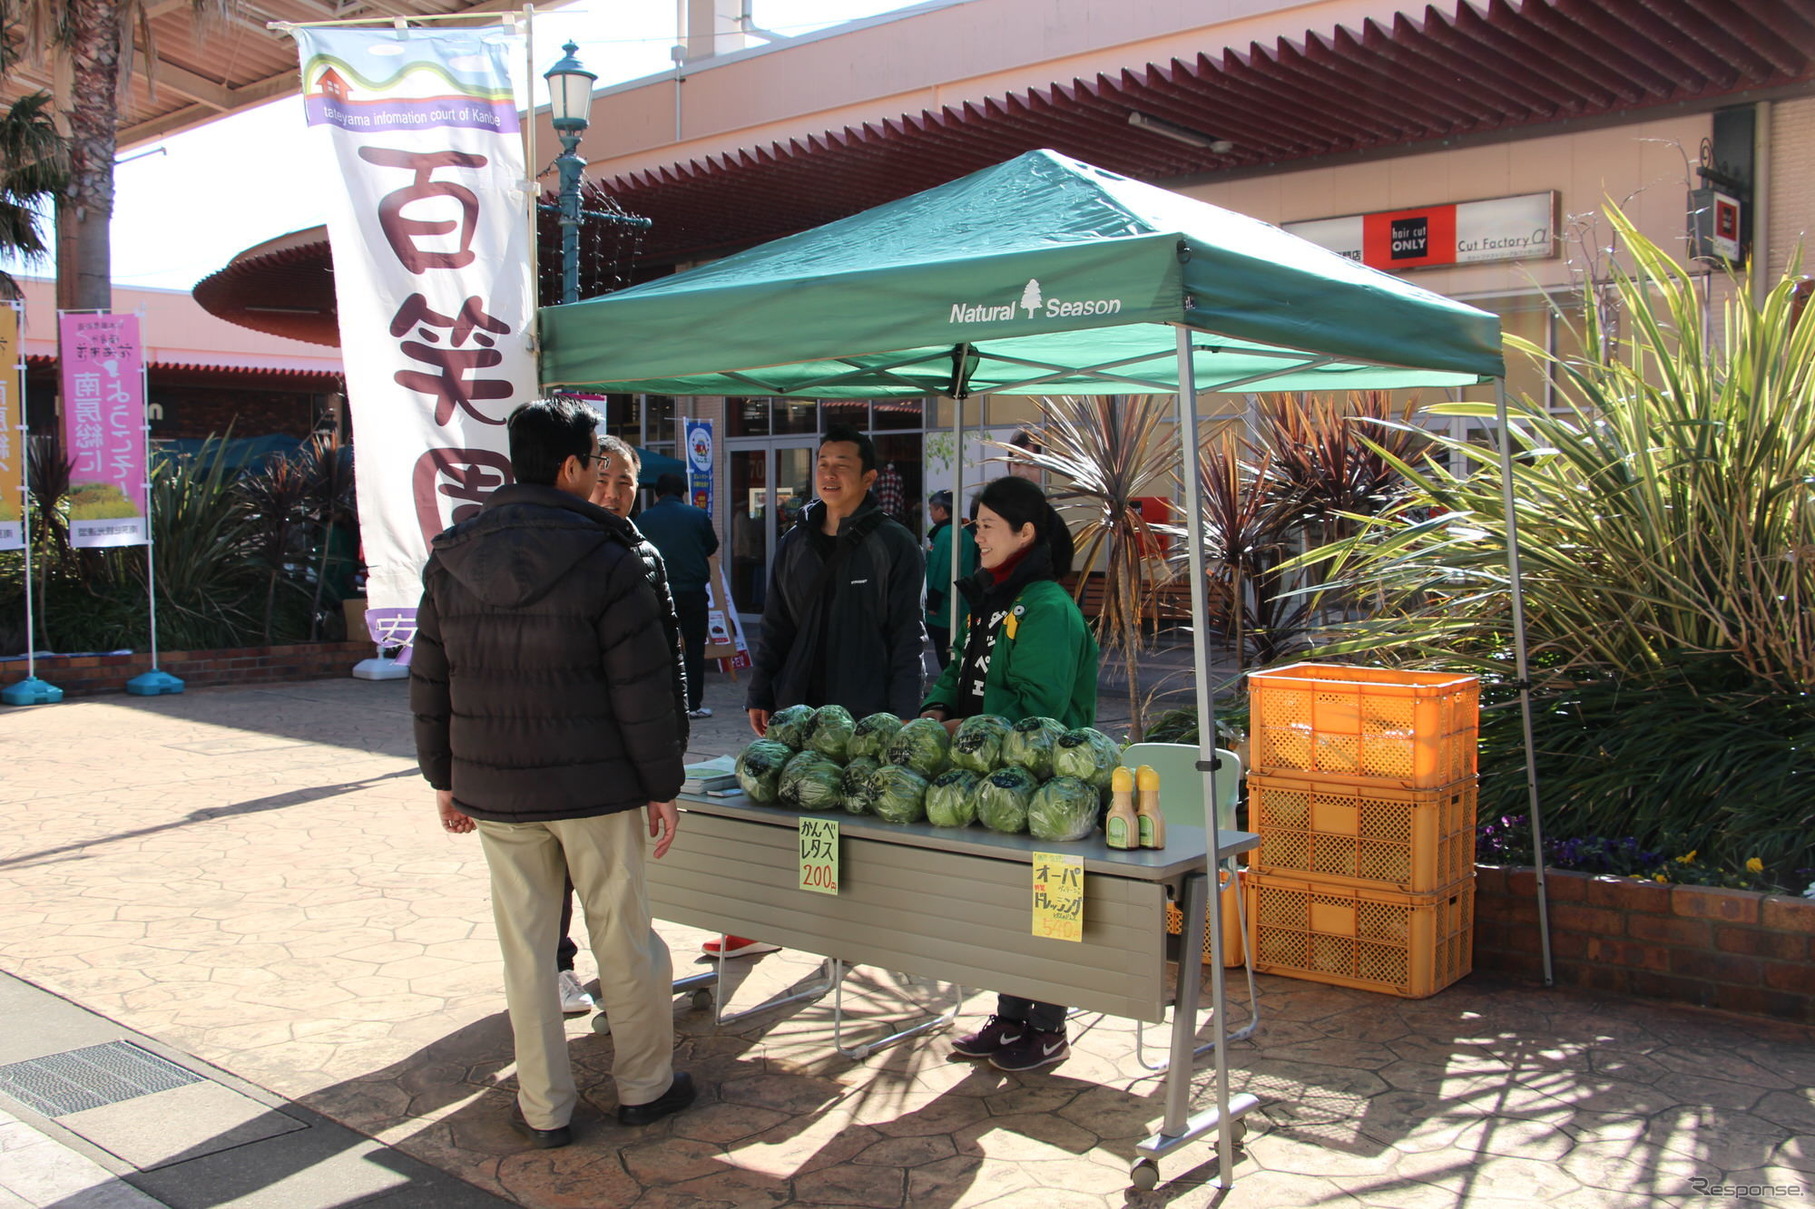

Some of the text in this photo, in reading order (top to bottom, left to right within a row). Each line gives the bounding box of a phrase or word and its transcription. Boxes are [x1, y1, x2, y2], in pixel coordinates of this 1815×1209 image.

[323, 106, 501, 127] tateyama infomation court of Kanbe
[1392, 226, 1426, 239] hair cut
[1392, 238, 1426, 252] ONLY
[1458, 240, 1478, 252] Cut
[1483, 237, 1530, 250] Factory
[949, 298, 1121, 323] Natural Season
[801, 821, 836, 839] かんべ
[801, 839, 834, 861] レタス
[1036, 865, 1080, 887] オーパ
[1035, 892, 1083, 916] ドレッシング
